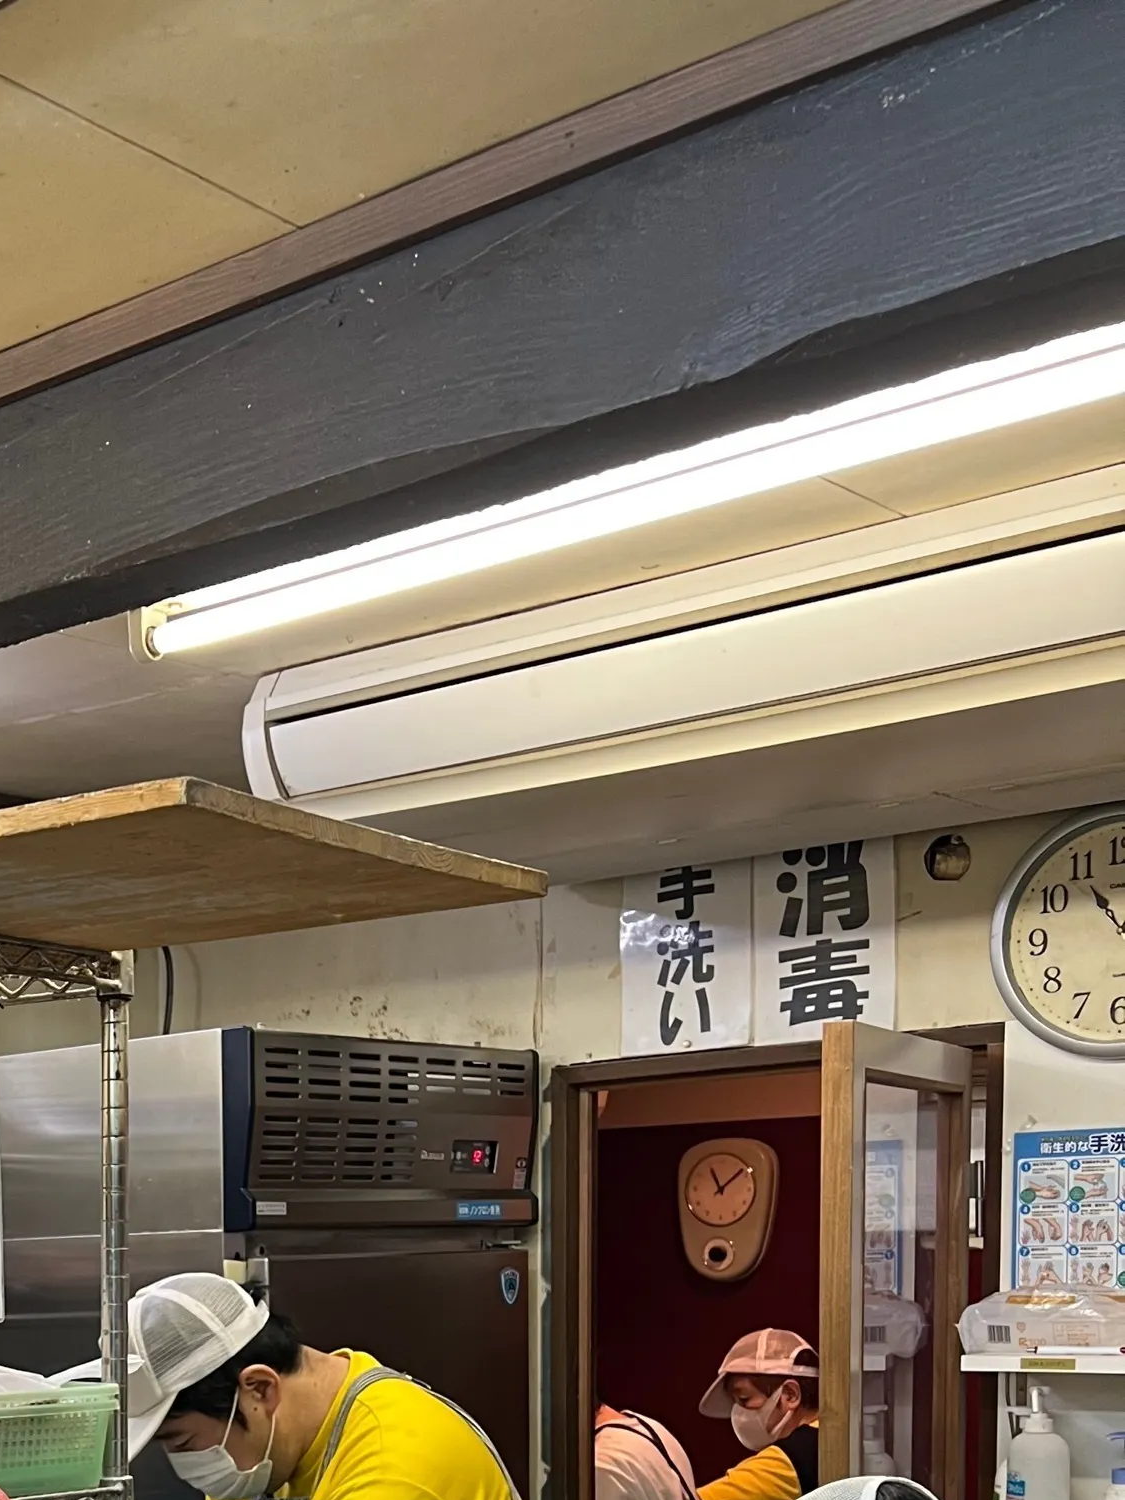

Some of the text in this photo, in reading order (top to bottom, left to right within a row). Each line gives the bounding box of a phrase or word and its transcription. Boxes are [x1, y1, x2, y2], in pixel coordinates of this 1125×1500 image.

[1069, 850, 1094, 881] 11
[1039, 883, 1069, 915] 10
[776, 840, 870, 1027] 消毒
[1028, 928, 1048, 956] 9
[656, 866, 715, 1046] 手洗い
[1043, 966, 1062, 994] 8
[1071, 991, 1091, 1020] 7
